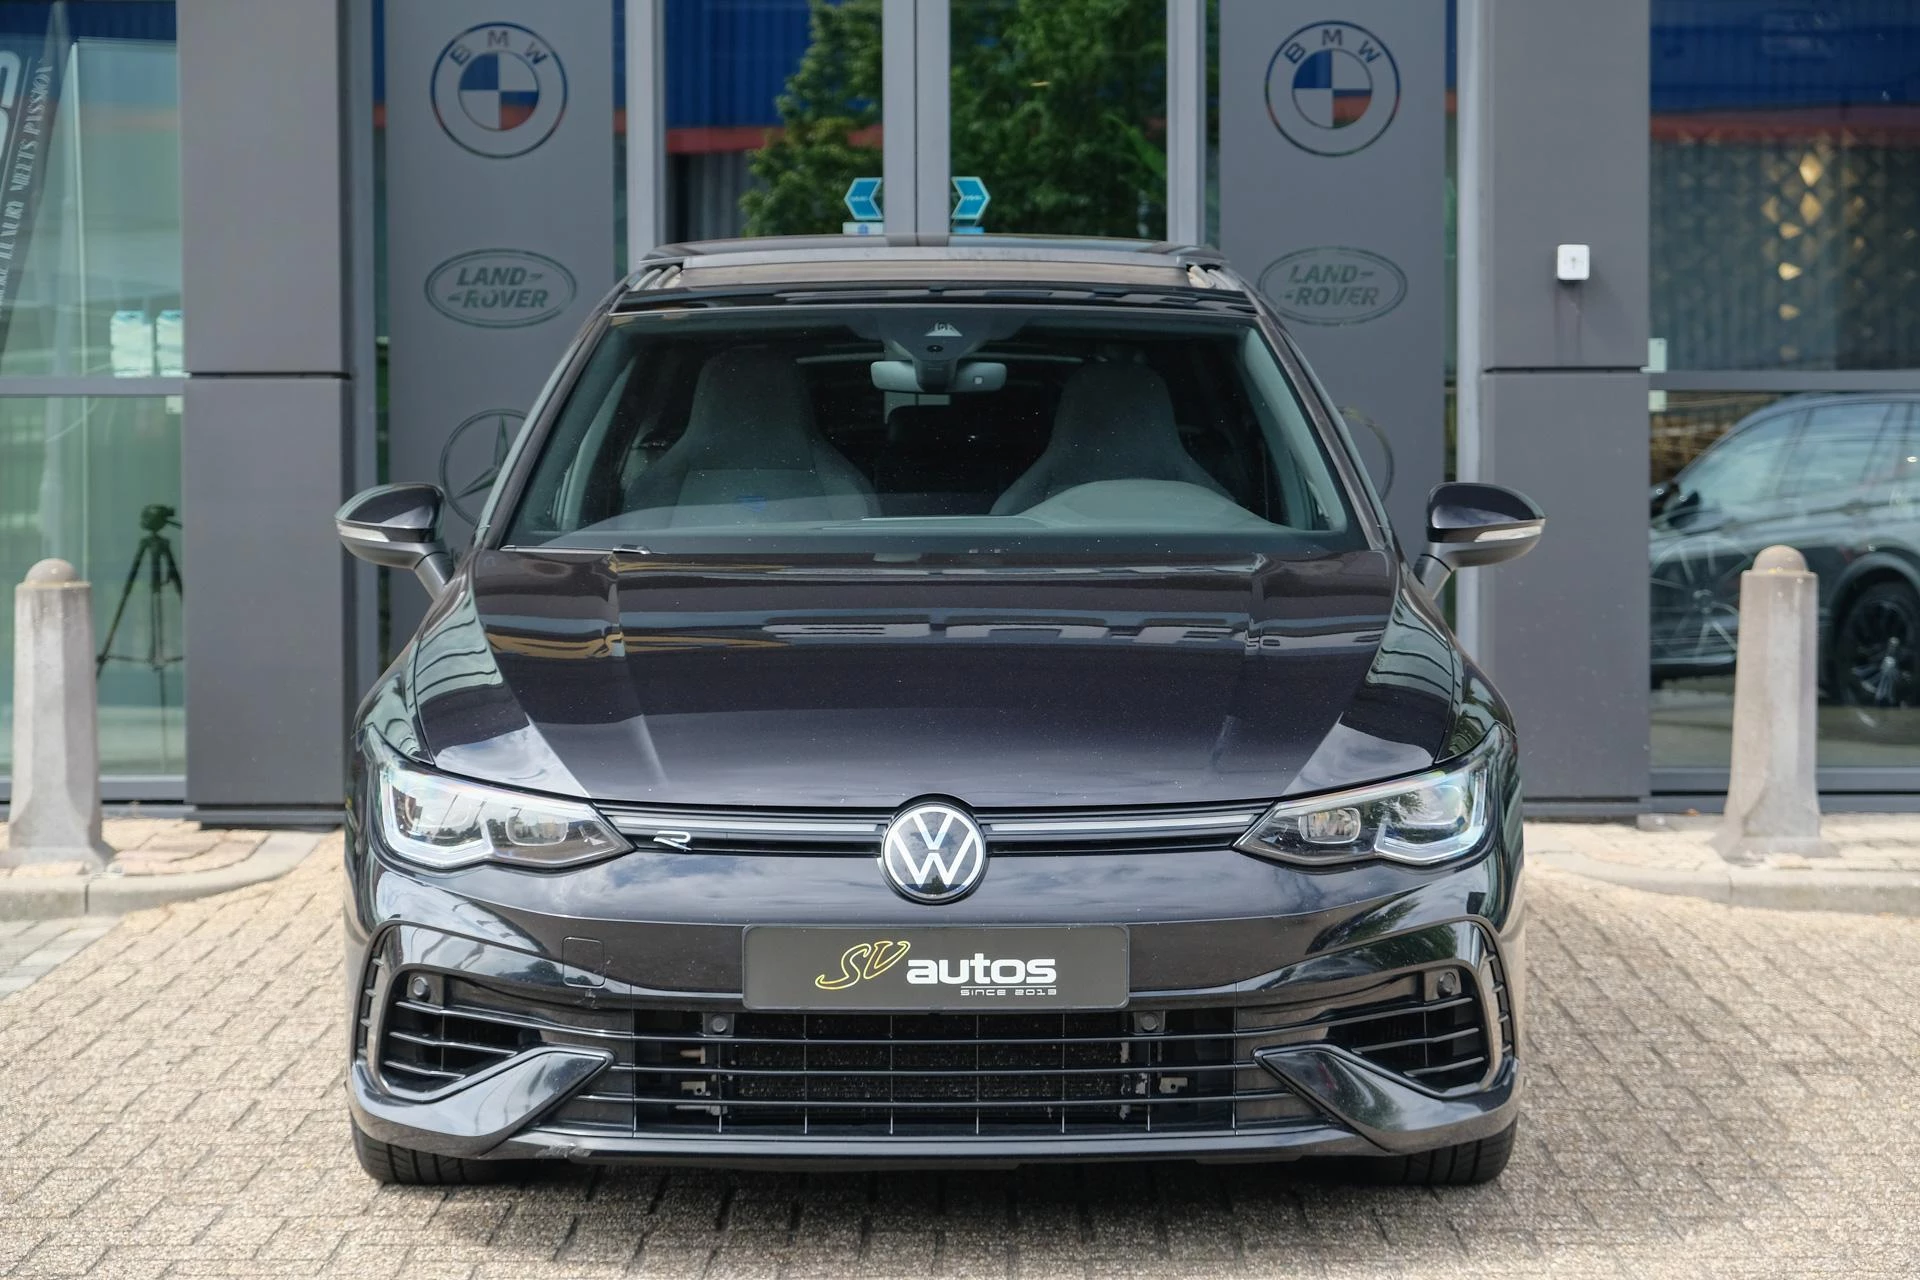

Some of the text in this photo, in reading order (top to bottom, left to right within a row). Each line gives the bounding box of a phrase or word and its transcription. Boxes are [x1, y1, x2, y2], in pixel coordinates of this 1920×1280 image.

[449, 30, 548, 66] BMW
[1284, 29, 1382, 65] BMW
[457, 267, 526, 287] LAND
[1288, 265, 1357, 285] LAND
[462, 289, 548, 309] ROVER
[1295, 286, 1379, 306] ROVER
[814, 940, 1057, 990] SV autos
